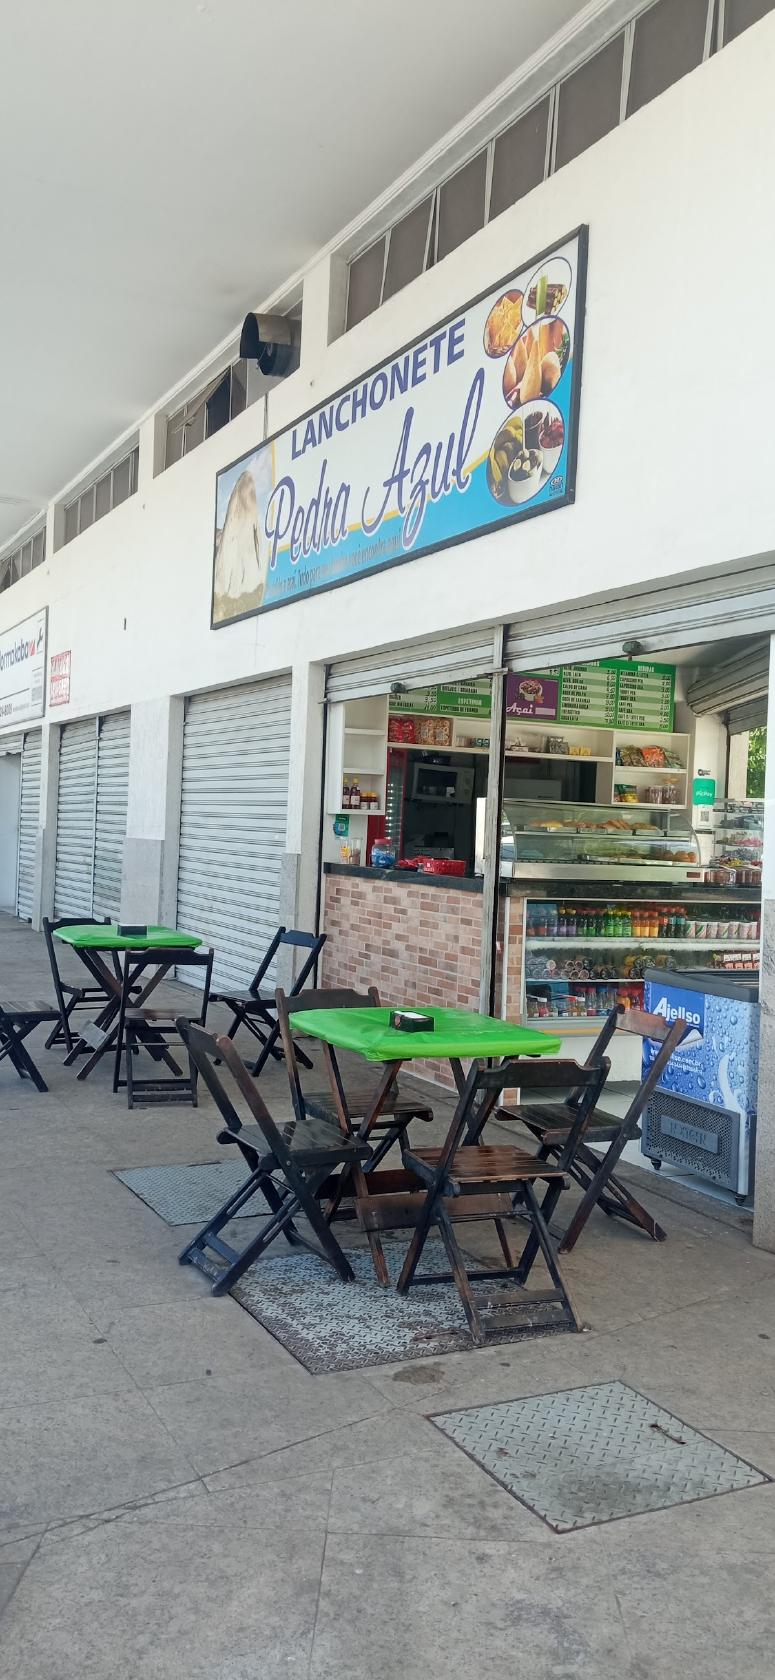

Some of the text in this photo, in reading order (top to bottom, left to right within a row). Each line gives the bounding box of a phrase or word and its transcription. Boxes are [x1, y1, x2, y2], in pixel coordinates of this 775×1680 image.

[291, 317, 466, 461] LANCHONETE
[264, 366, 486, 569] Pedra Azul
[652, 996, 701, 1025] Ajellso
